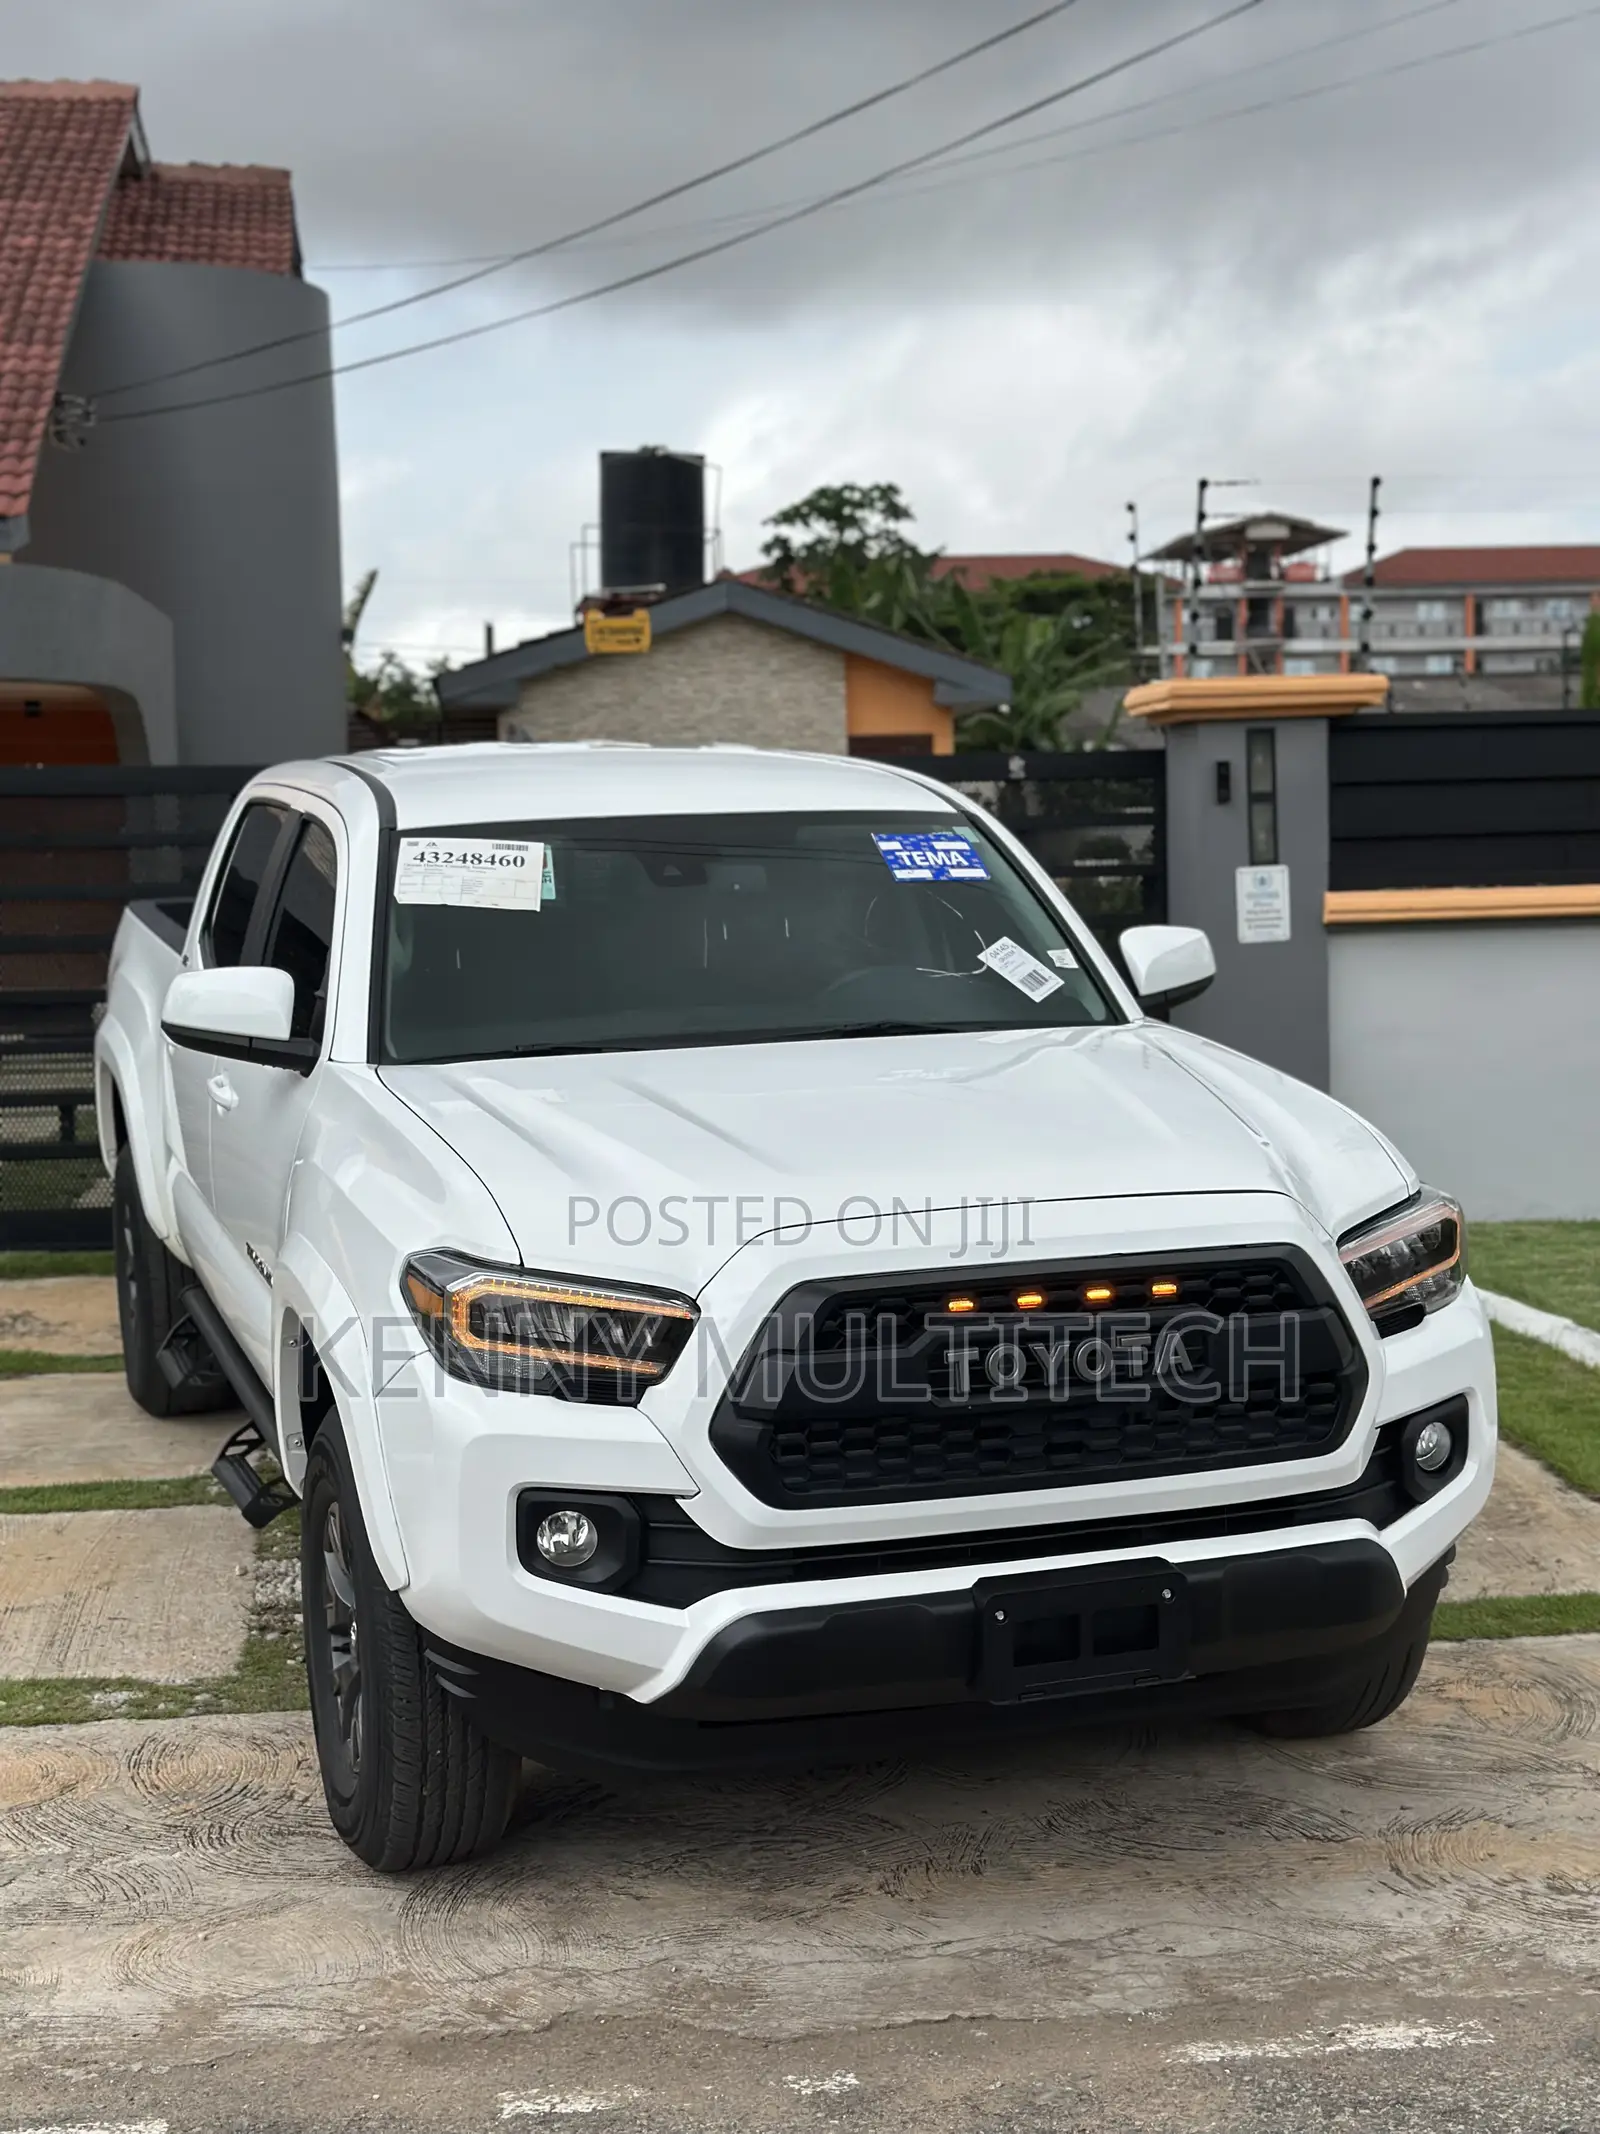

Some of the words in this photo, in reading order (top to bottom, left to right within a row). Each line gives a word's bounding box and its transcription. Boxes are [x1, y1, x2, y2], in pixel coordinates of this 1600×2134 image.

[412, 851, 526, 868] 43248460
[894, 850, 970, 867] TEMA
[944, 1330, 1194, 1395] TOYOTA
